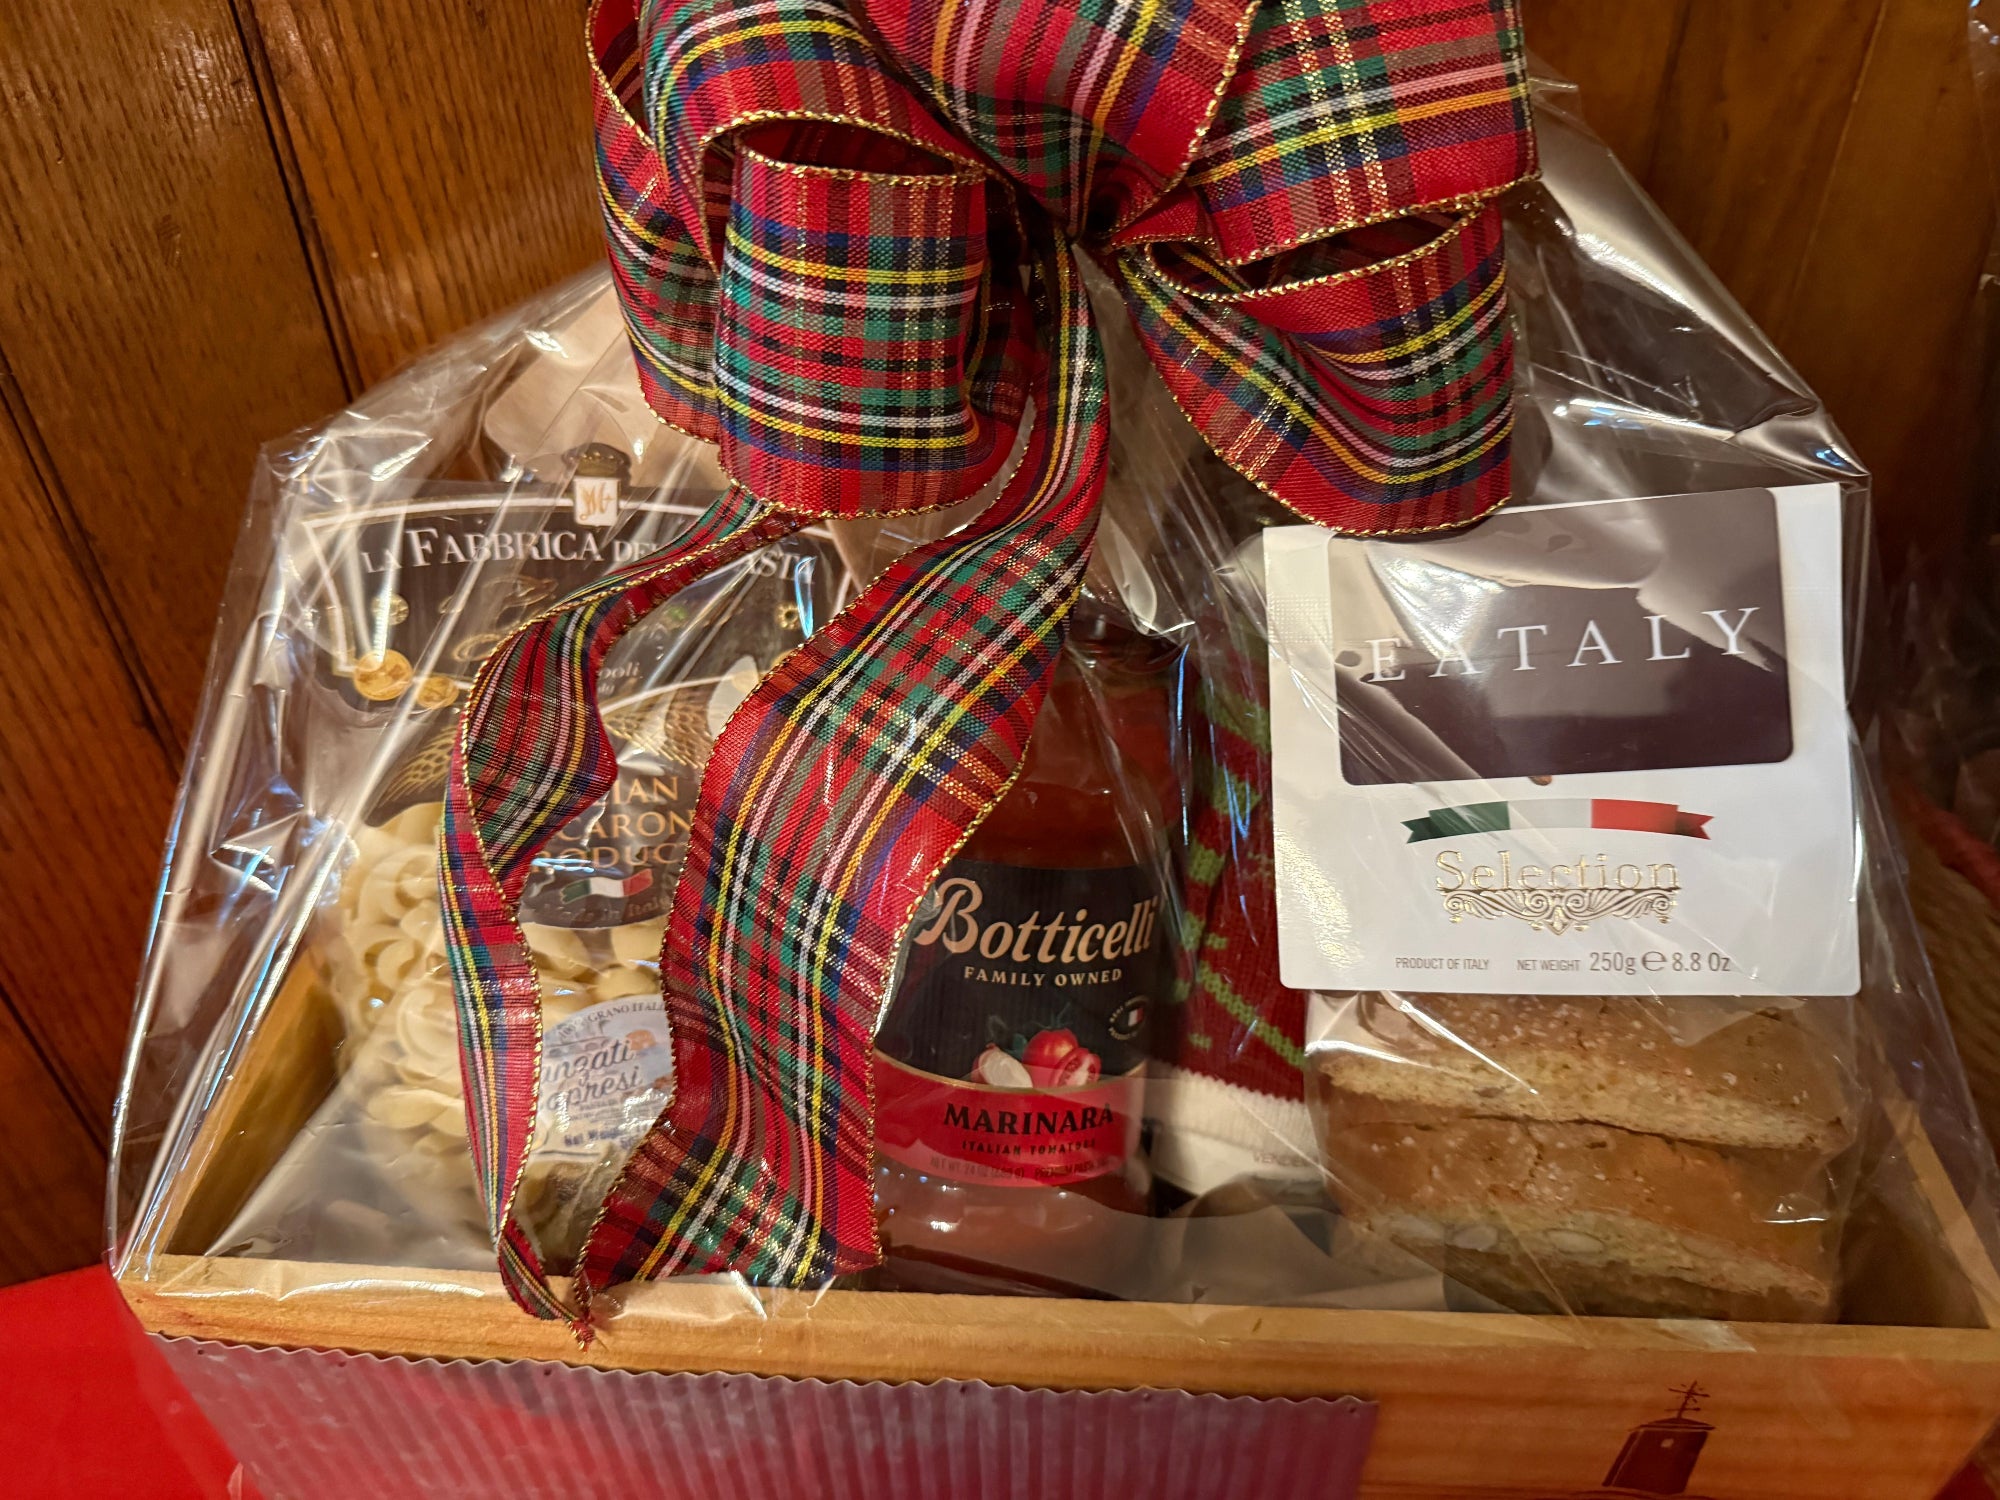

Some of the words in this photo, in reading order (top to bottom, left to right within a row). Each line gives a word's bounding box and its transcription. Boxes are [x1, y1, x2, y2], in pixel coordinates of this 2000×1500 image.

[361, 550, 402, 573] LA
[406, 528, 604, 567] FABBRICA
[1366, 606, 1760, 682] EATALY
[1436, 850, 1681, 890] Selection
[914, 877, 1158, 964] Botticelli
[964, 965, 1046, 987] FAMILY
[1054, 968, 1122, 987] OWNED
[1395, 957, 1444, 969] PRODUCT
[1447, 958, 1461, 969] OF
[1463, 958, 1489, 970] ITALY
[1517, 959, 1537, 970] NET
[1541, 959, 1580, 971] WEIGHT
[1589, 952, 1637, 976] 250g
[1672, 953, 1702, 972] 8.8
[943, 1102, 1114, 1135] MARINARA
[962, 1140, 1021, 1155] ITALIAN
